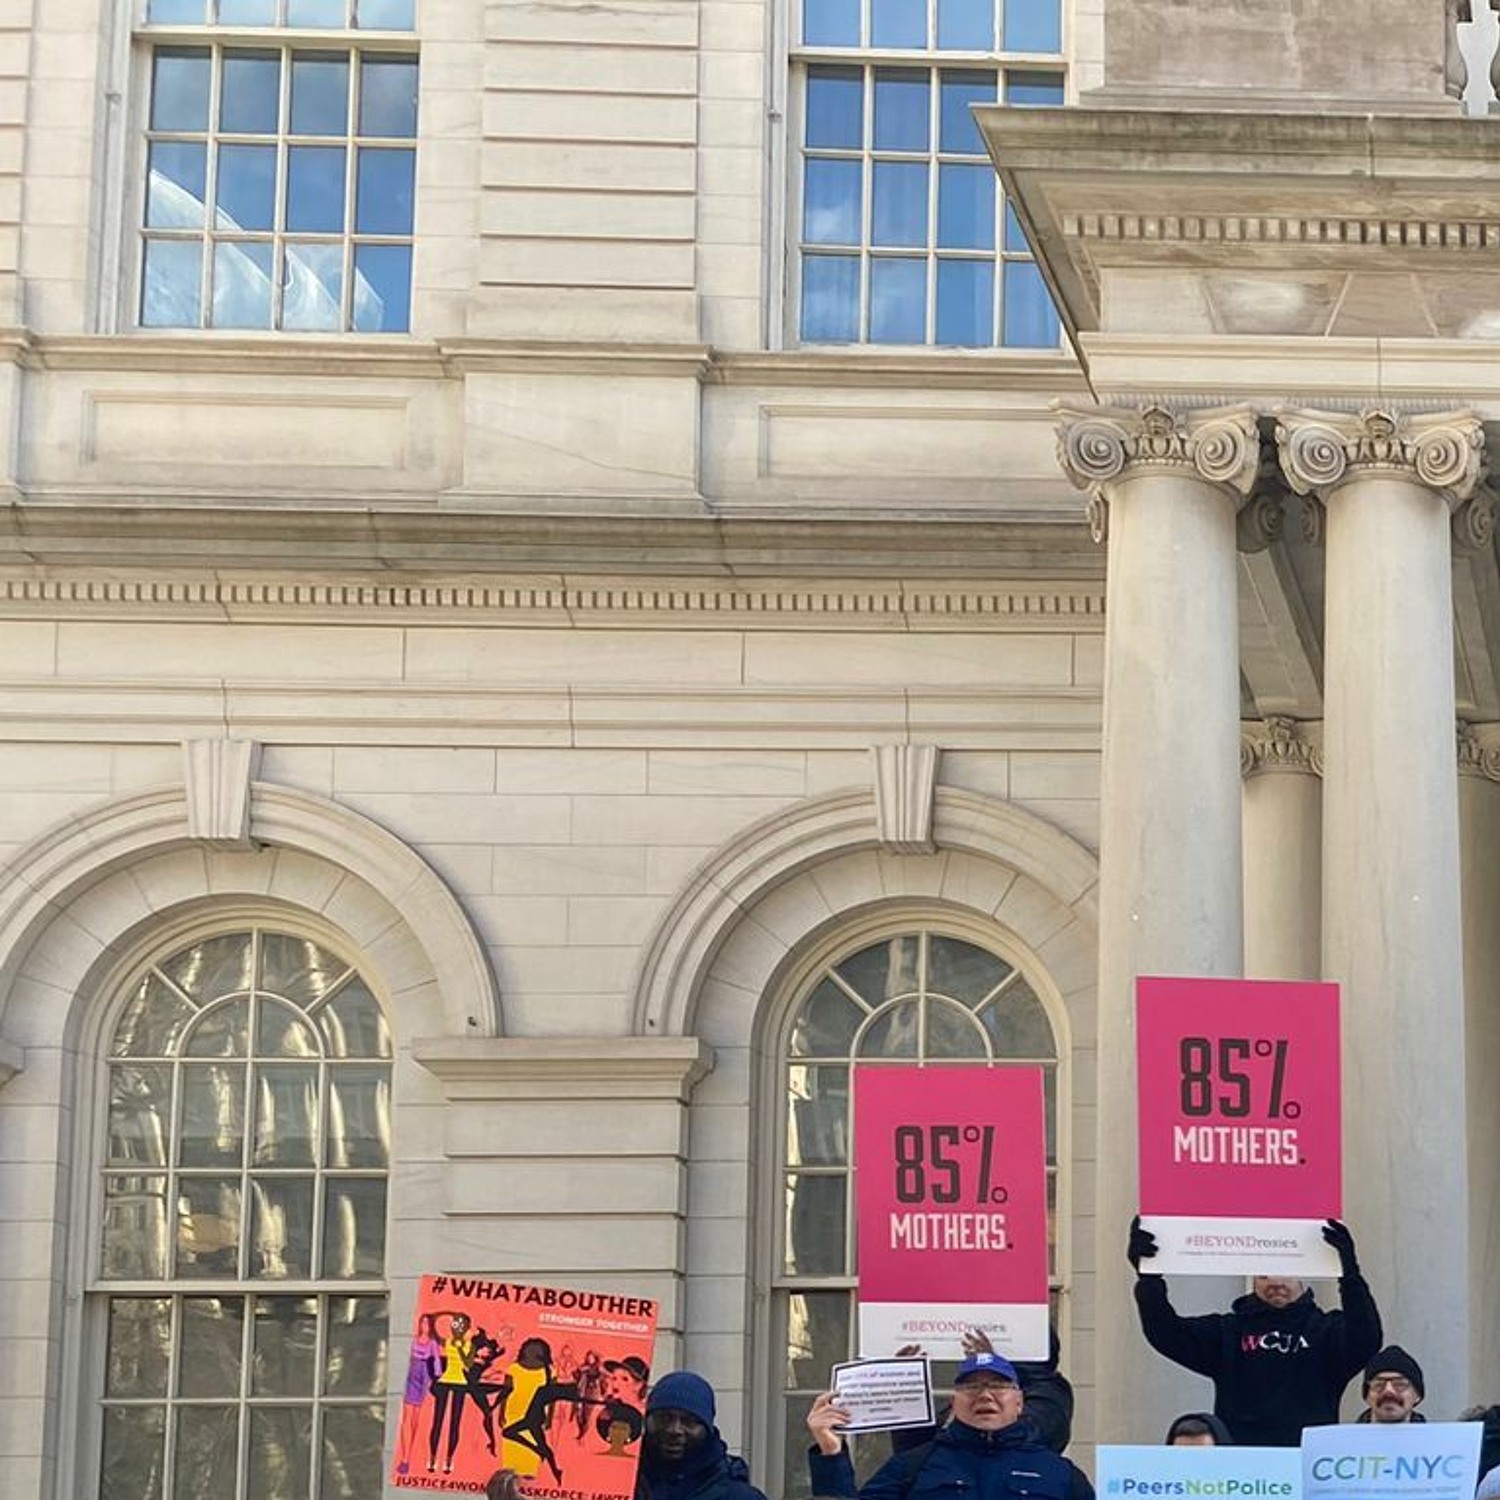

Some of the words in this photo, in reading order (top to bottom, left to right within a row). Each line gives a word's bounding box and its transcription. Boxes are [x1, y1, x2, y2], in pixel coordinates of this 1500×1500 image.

[1181, 1036, 1301, 1120] 85%
[894, 1125, 1008, 1204] 85%
[1174, 1126, 1306, 1165] MOTHERS.
[891, 1213, 1014, 1251] MOTHERS.
[432, 1277, 653, 1318] #WHATABOUTHER
[1107, 1477, 1293, 1496] #PeersNotPolice
[1311, 1455, 1465, 1482] CCIT-NYC
